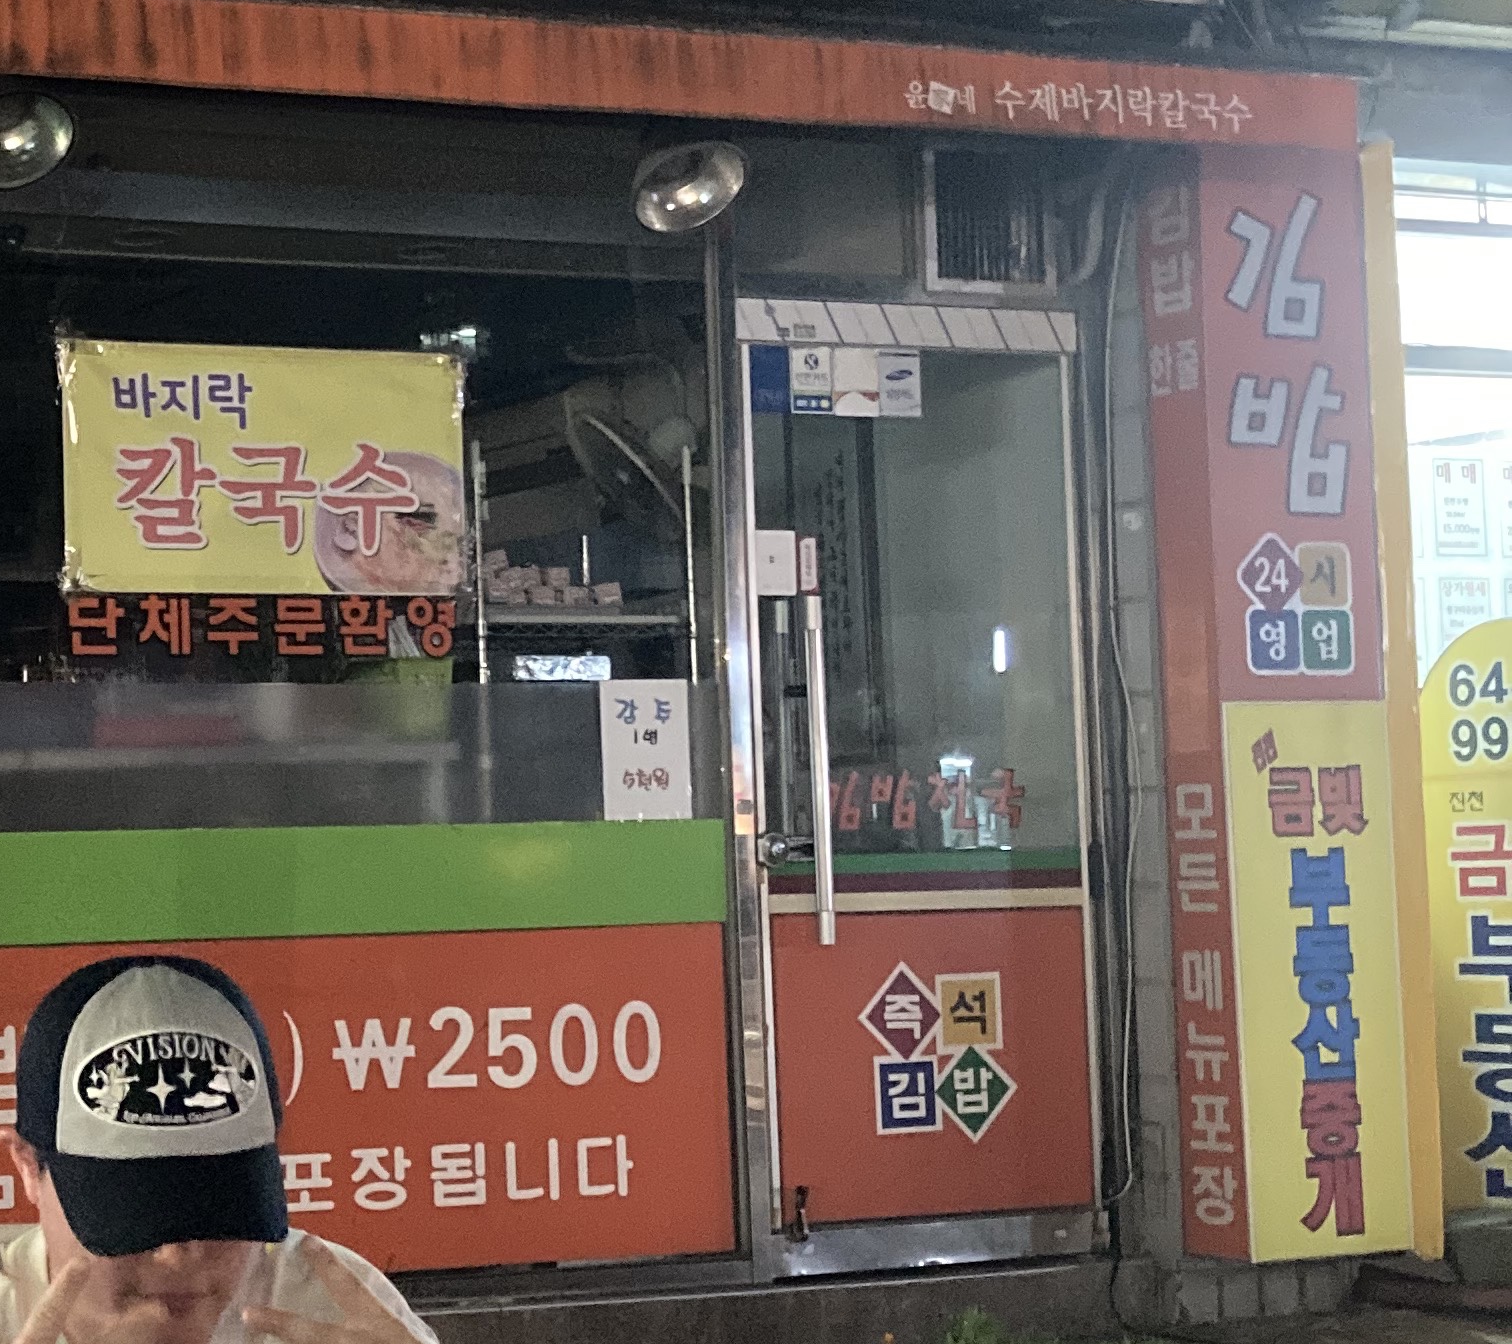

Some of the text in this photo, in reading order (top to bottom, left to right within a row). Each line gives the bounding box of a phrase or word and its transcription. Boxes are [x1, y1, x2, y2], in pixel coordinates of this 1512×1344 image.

[1223, 192, 1350, 517] 김밥
[111, 372, 254, 431] 바지락
[114, 435, 421, 558] 칼국수
[66, 594, 459, 659] 단체주문환영
[1258, 618, 1340, 664] 영업
[1265, 762, 1370, 838] 금빛
[882, 988, 989, 1039] 즉석
[886, 1067, 992, 1120] 김밥
